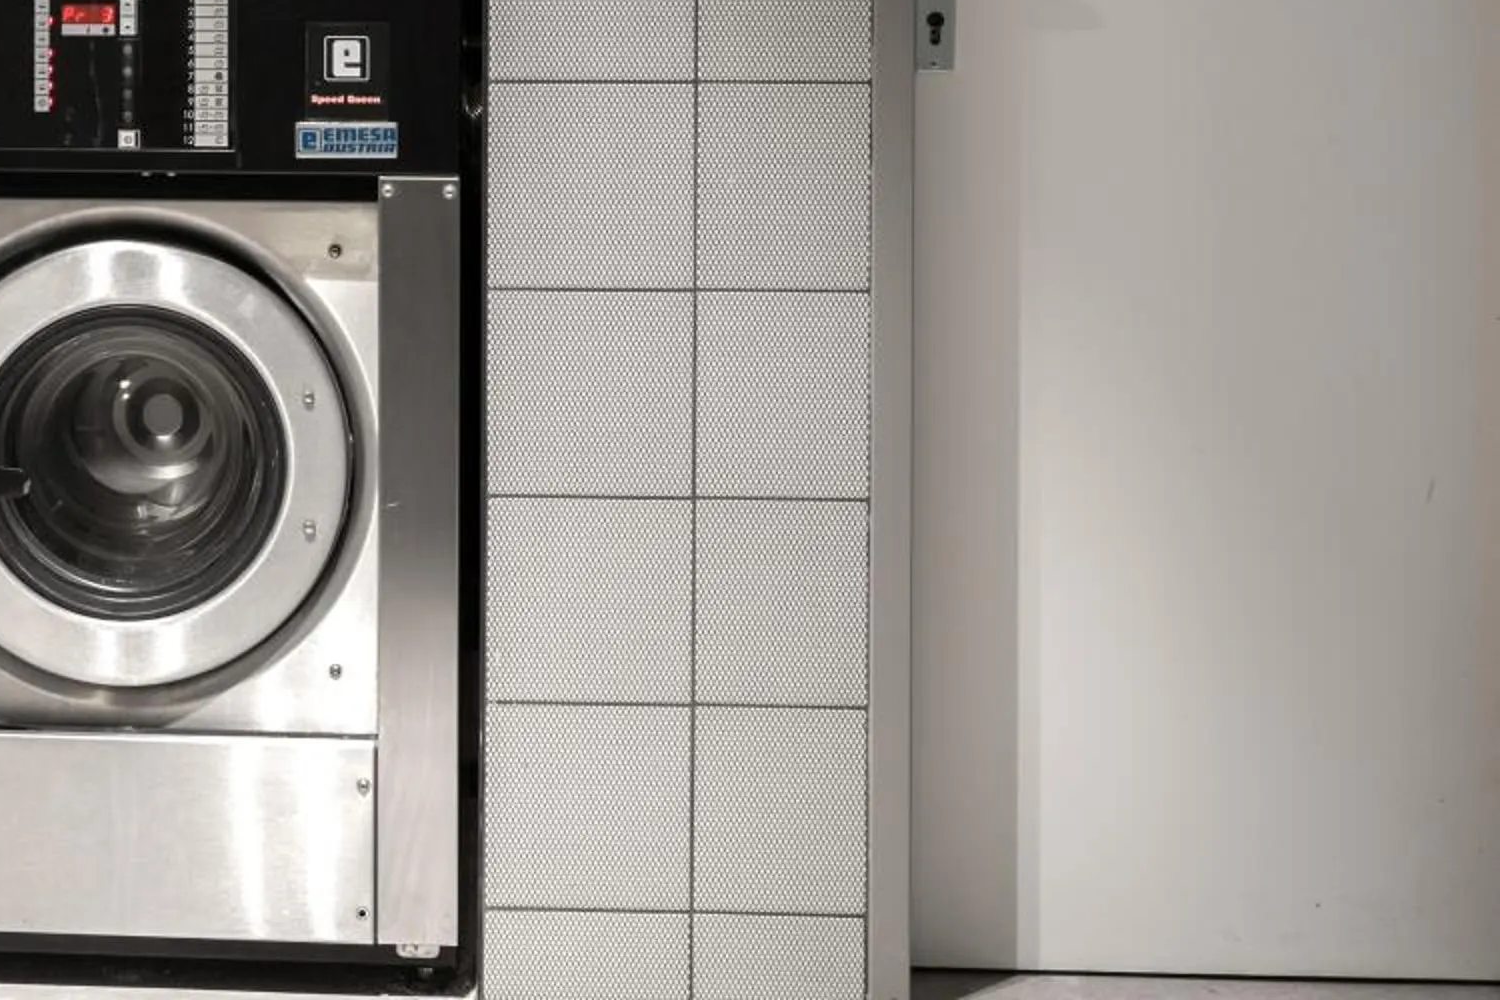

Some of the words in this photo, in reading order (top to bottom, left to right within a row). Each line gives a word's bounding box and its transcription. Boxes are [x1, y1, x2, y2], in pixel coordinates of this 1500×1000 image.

[311, 94, 345, 105] Speed
[347, 94, 381, 104] Queen
[323, 128, 396, 141] EMESA
